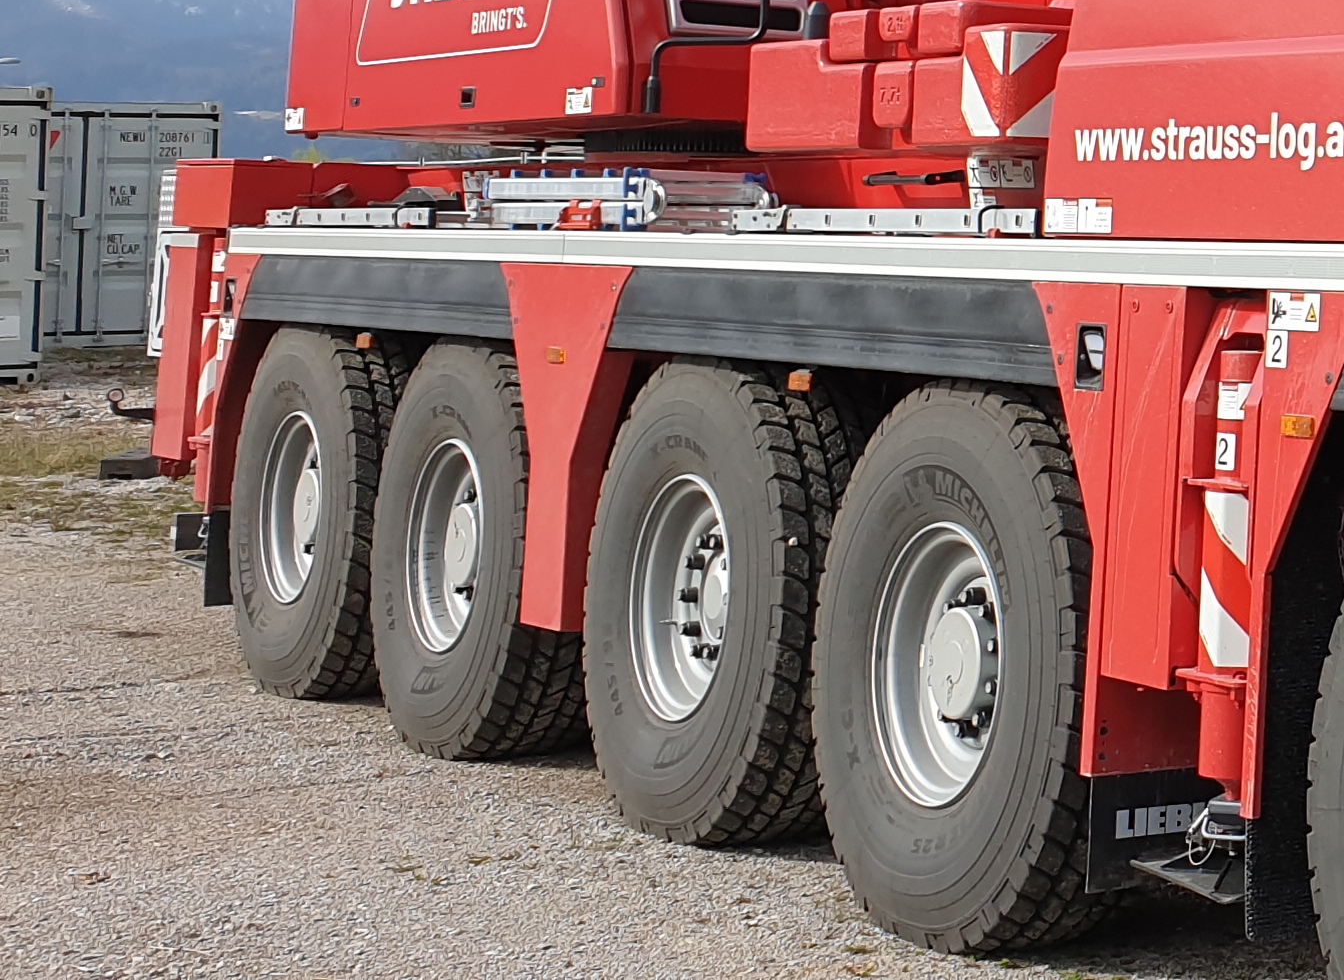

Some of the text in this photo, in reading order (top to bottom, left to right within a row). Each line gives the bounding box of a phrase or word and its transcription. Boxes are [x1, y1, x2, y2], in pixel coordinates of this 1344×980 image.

[471, 6, 529, 35] BRINGT'S.
[0, 124, 18, 137] 54
[119, 132, 146, 143] NEWU
[158, 132, 196, 144] 208761
[158, 146, 183, 157] 22G1
[109, 195, 133, 207] TARE
[1271, 335, 1283, 363] 2
[1217, 437, 1229, 466] 2
